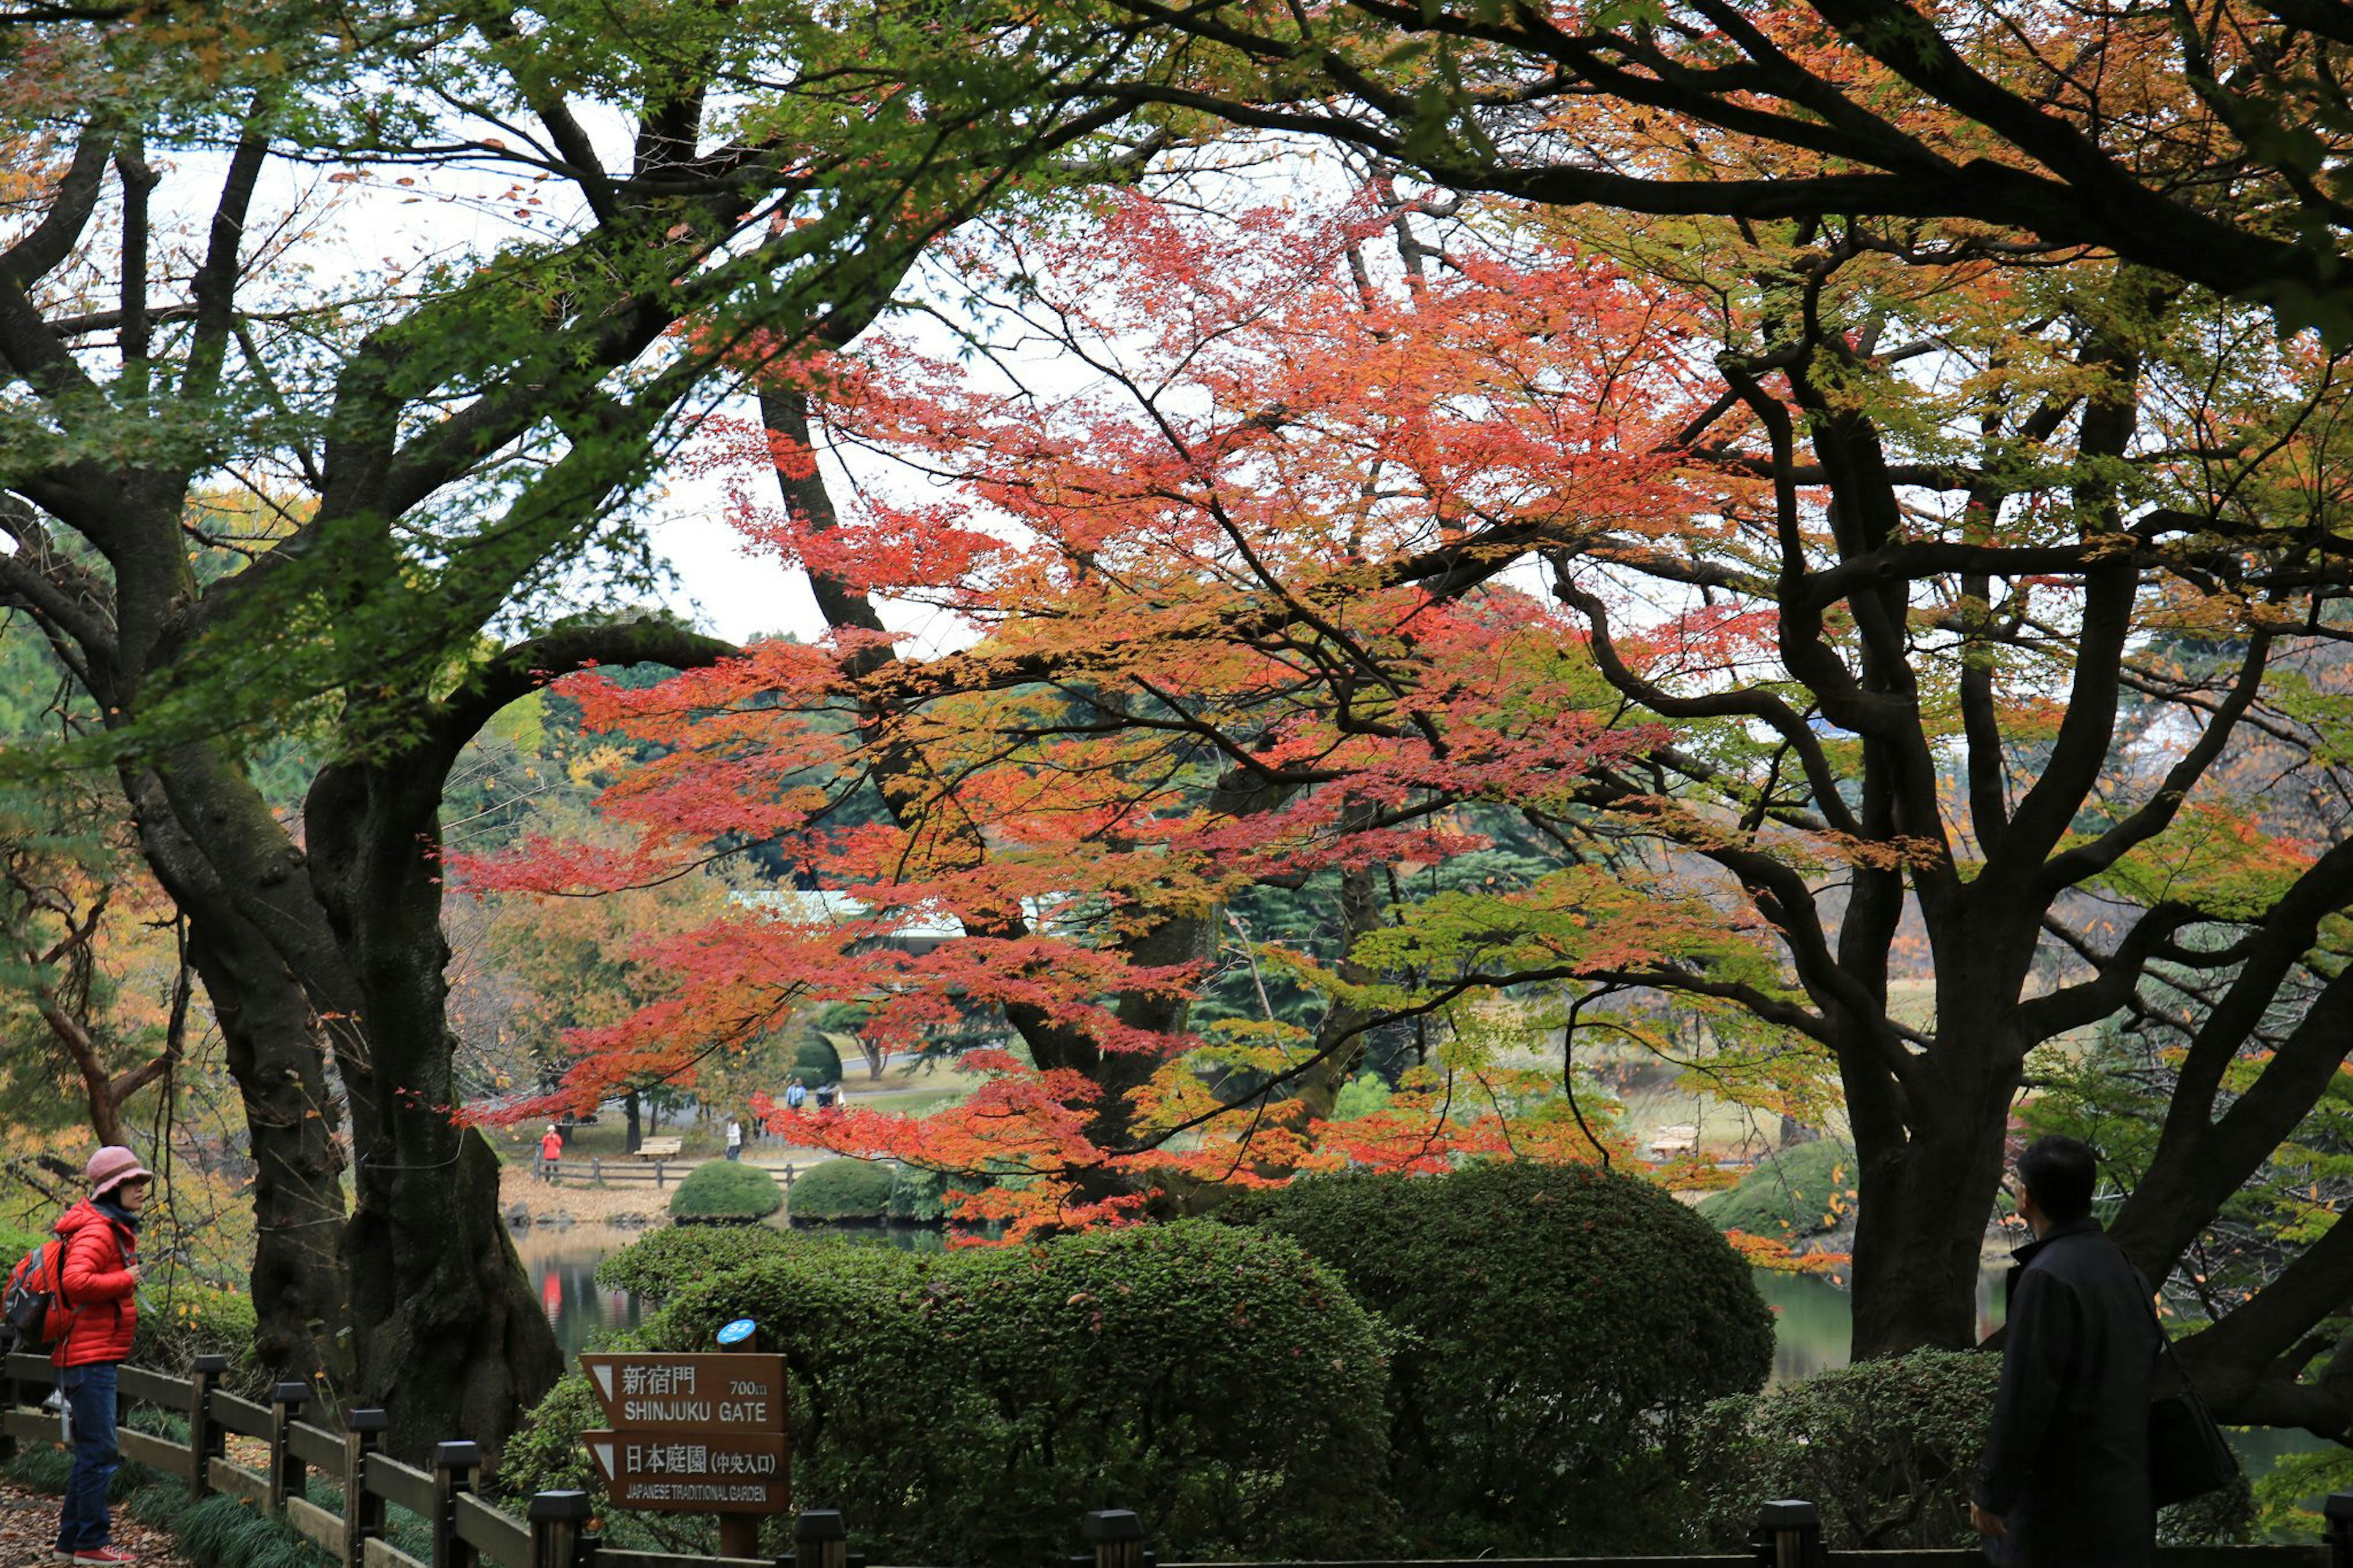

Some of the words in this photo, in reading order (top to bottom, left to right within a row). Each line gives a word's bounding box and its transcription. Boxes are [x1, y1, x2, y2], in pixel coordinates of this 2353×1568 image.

[727, 1322, 750, 1333] S2
[622, 1365, 695, 1395] 新宿門
[730, 1381, 767, 1396] 700m
[624, 1401, 710, 1421] SHINJUKU
[719, 1402, 767, 1422] GATE
[627, 1483, 670, 1499] JAPANESE
[671, 1484, 728, 1501] TRADITIONAL
[729, 1485, 766, 1502] GARDEN
